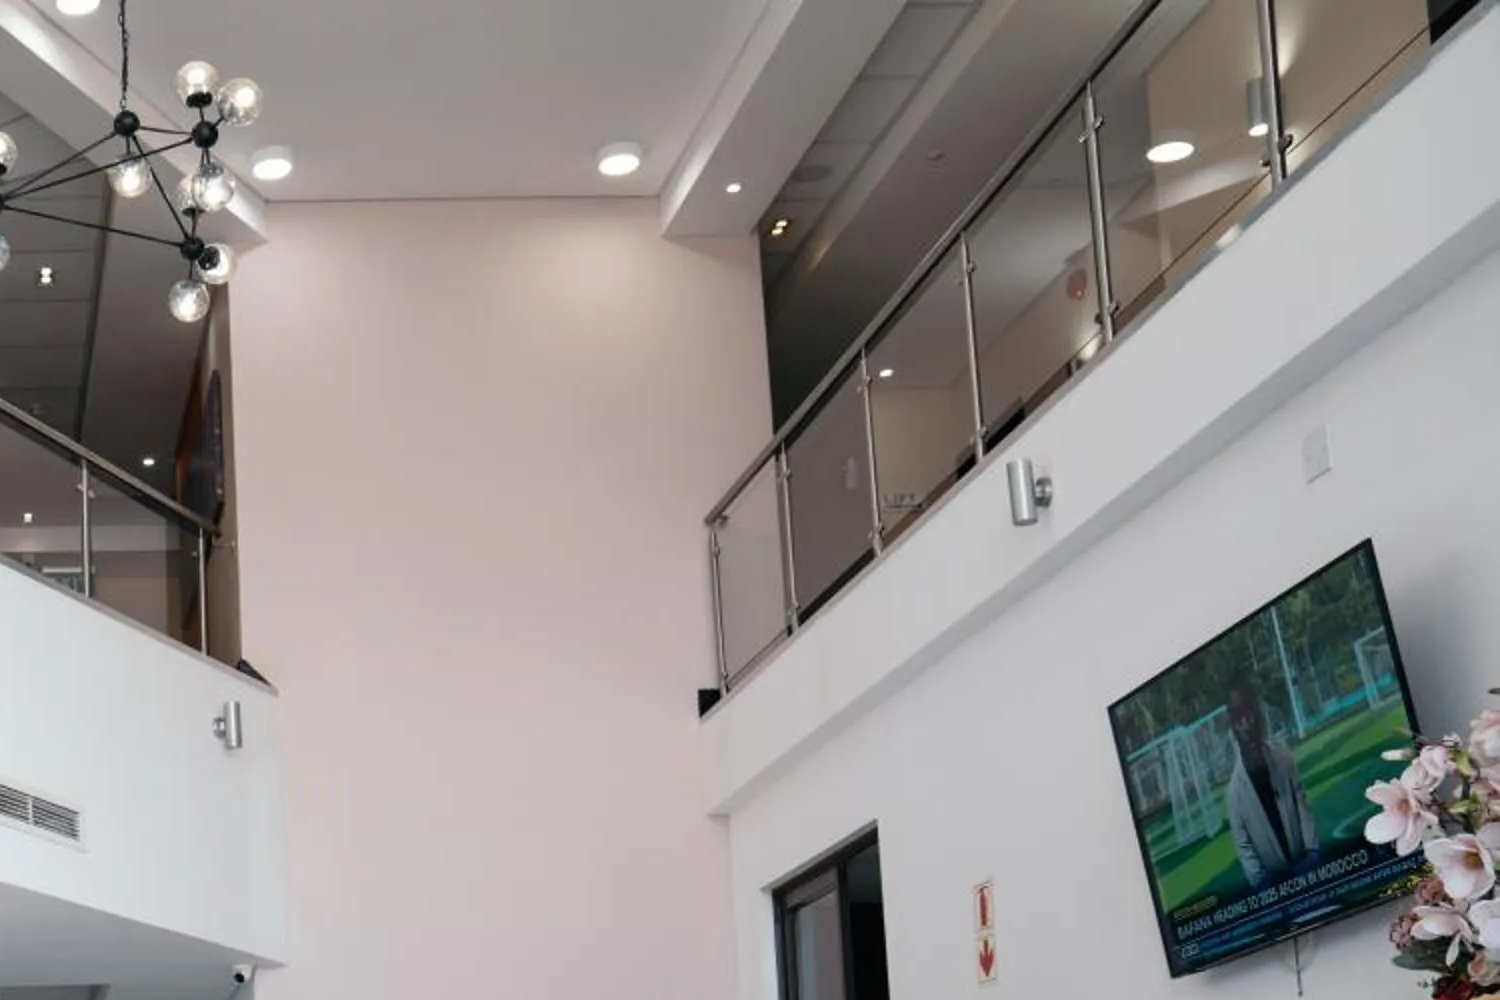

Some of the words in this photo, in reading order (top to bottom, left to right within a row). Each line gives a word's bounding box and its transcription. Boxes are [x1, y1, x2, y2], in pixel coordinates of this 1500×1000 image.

[1213, 900, 1248, 923] HEADING
[1279, 876, 1307, 897] AFCON
[1317, 849, 1369, 881] MOROCCO
